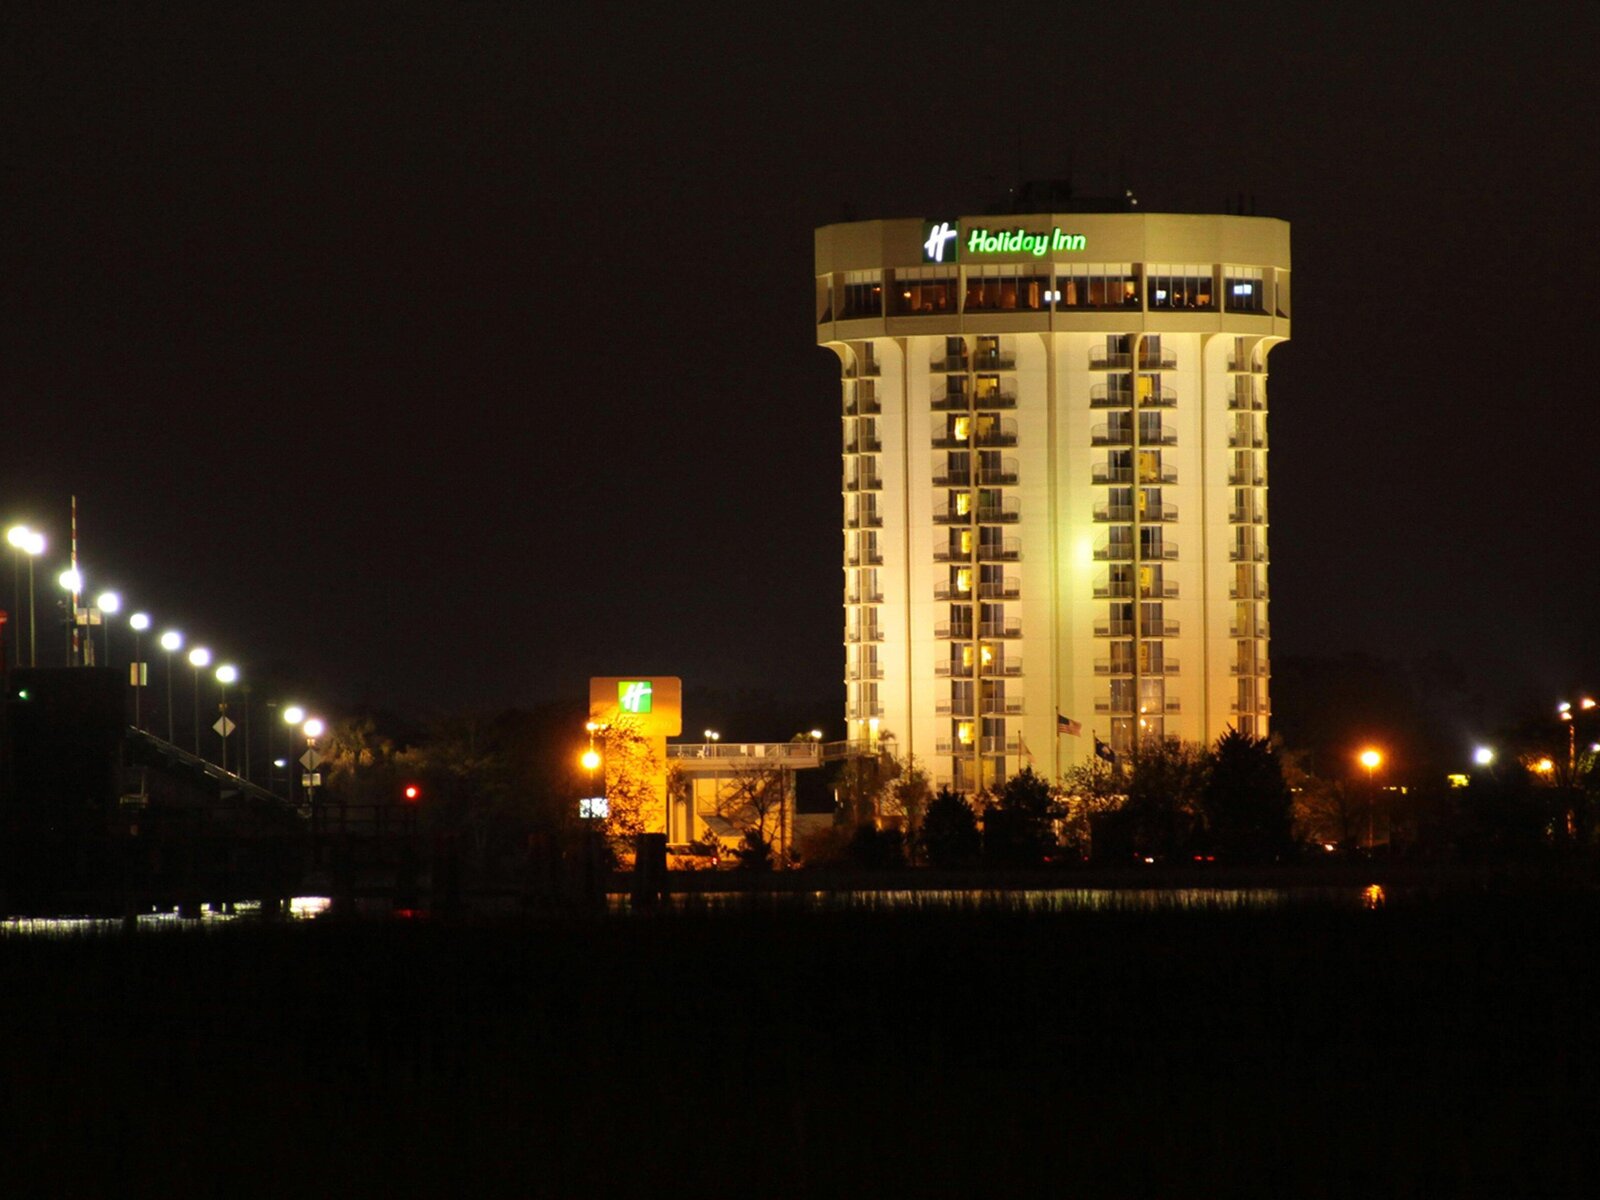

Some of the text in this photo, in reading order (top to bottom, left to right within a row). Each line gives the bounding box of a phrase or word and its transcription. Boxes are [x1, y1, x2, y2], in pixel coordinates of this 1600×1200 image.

[924, 222, 1086, 262] H Holiday Inn
